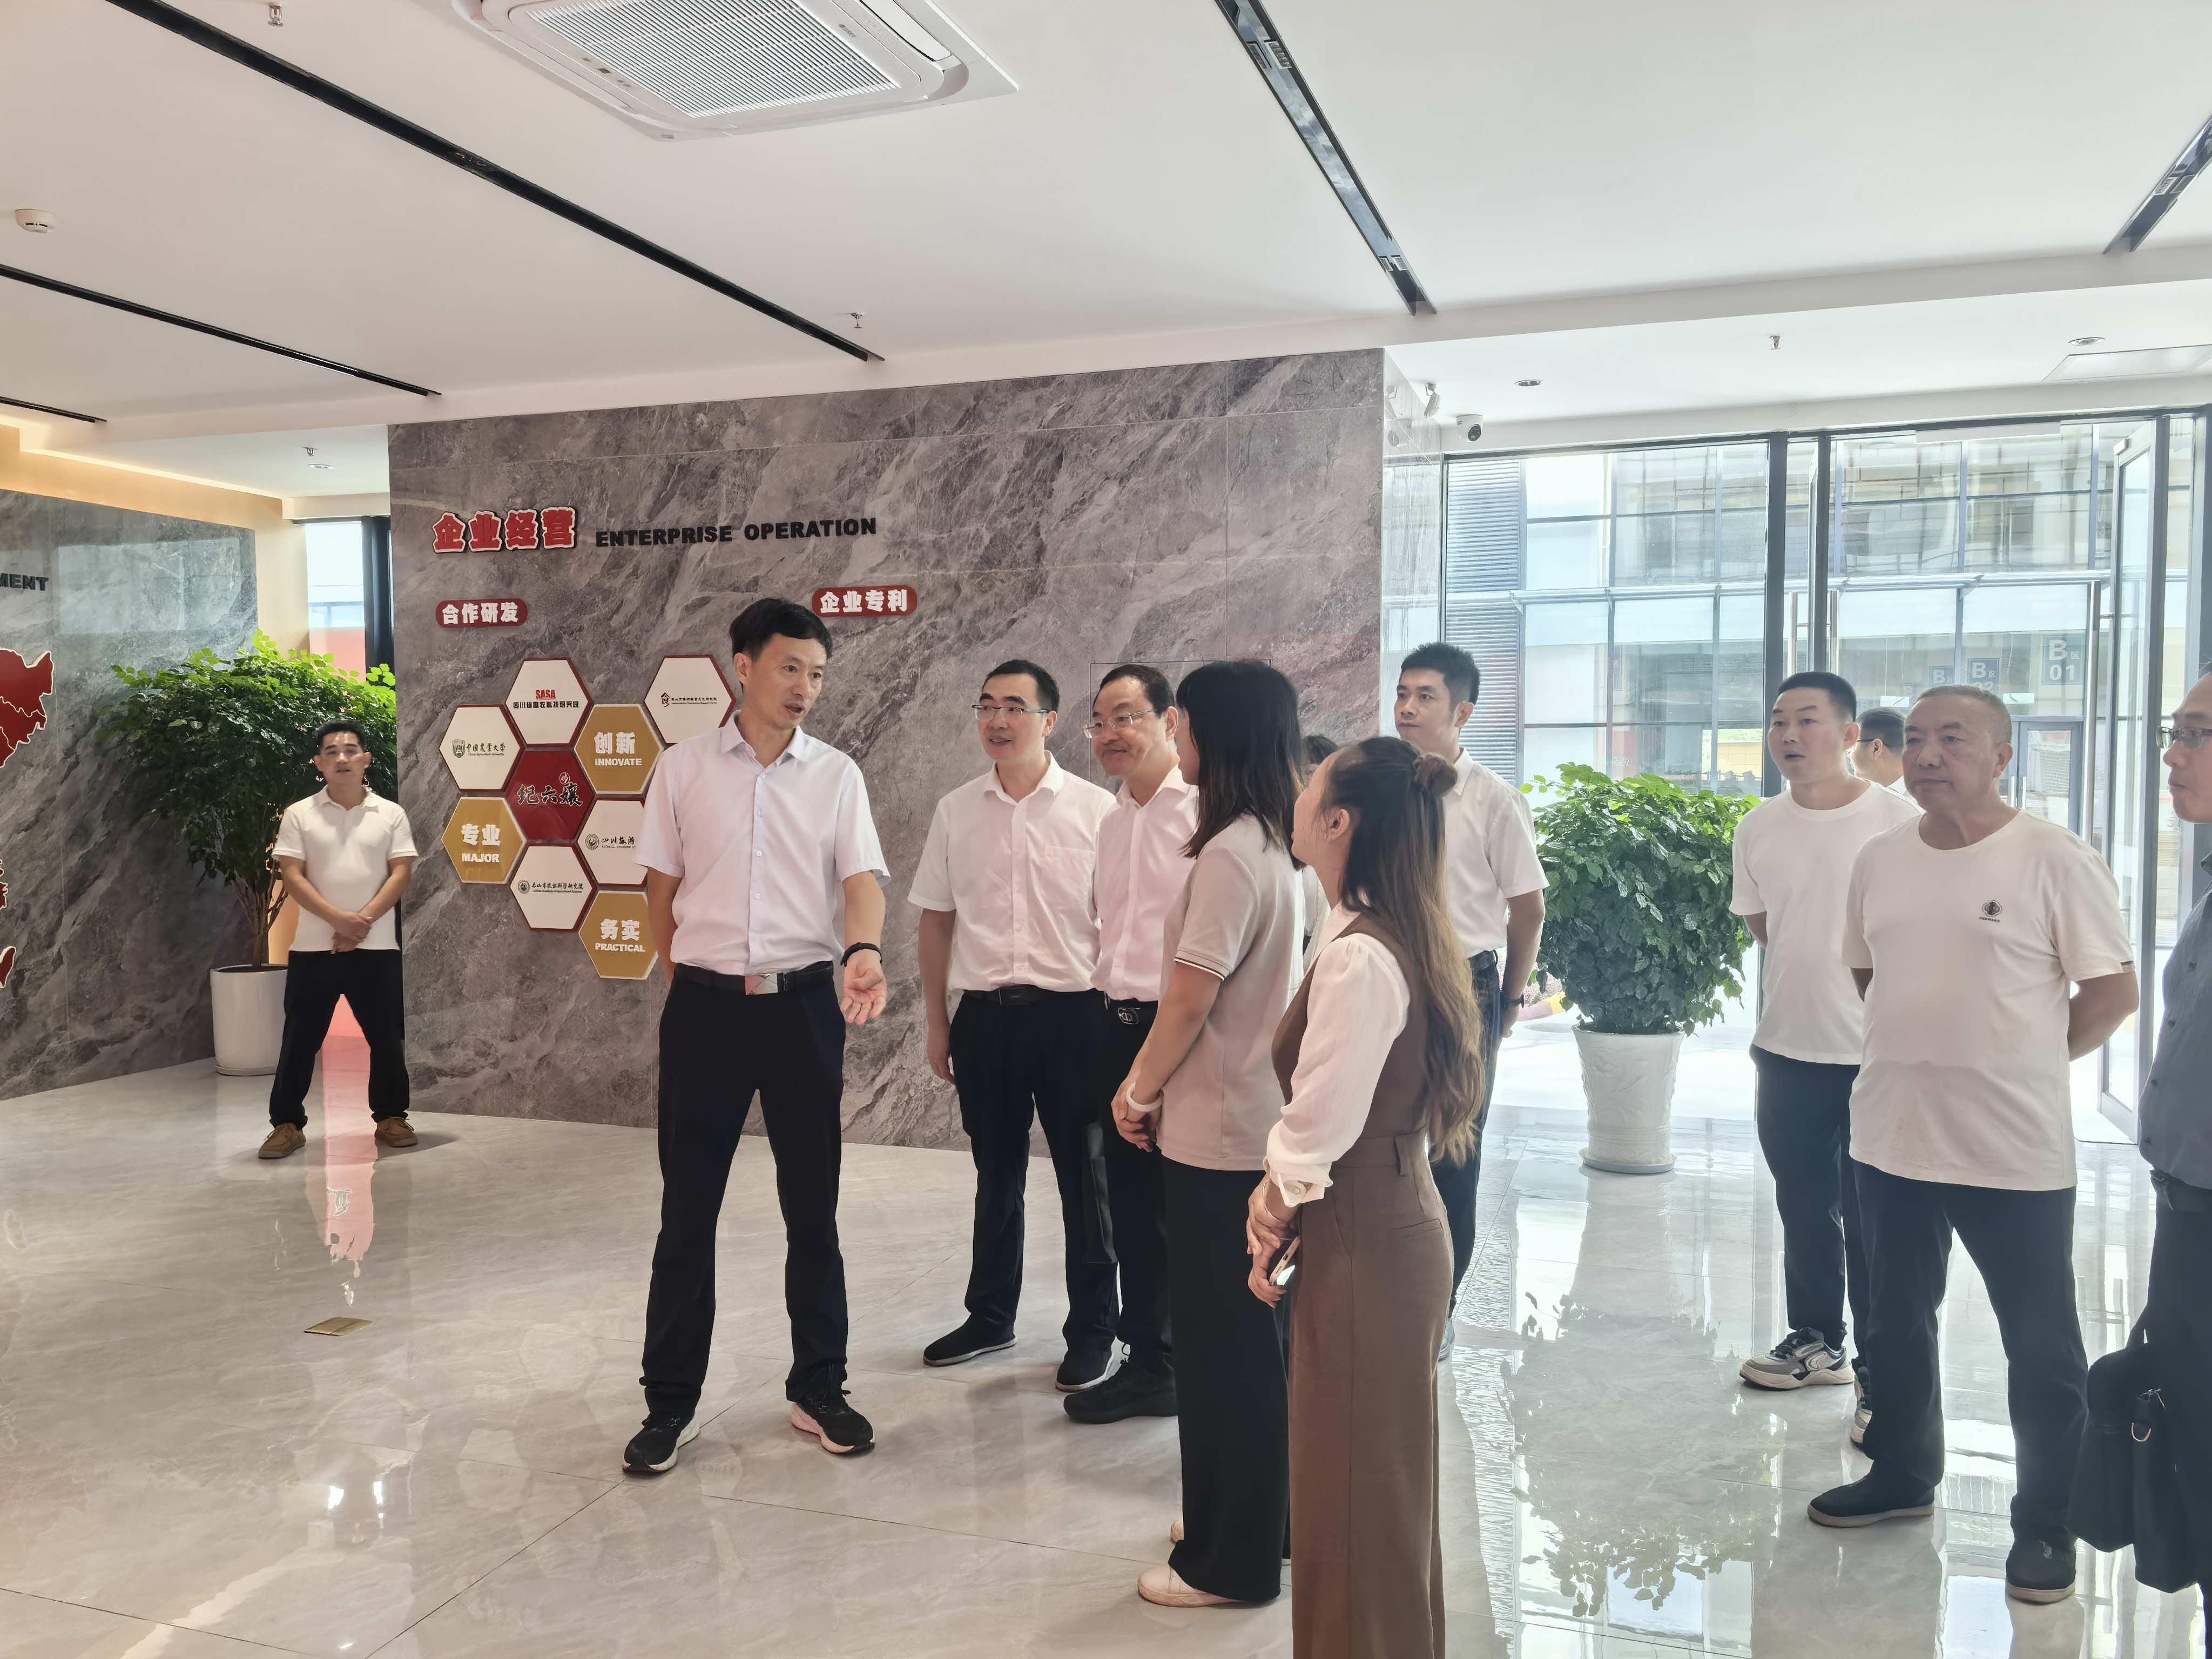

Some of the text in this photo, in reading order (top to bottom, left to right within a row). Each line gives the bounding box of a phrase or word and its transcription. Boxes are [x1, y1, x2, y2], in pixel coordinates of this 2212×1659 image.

[433, 507, 575, 552] 企业经营
[596, 518, 876, 547] ENTERPRISE OPERATION
[820, 589, 907, 613] 企业专利
[442, 602, 518, 624] 合作研发
[2049, 664, 2074, 680] 01
[536, 689, 556, 699] SASA
[594, 732, 635, 754] 创新
[595, 758, 642, 766] INNOVATE
[461, 824, 501, 846] 专业
[462, 853, 500, 863] MAJOR
[600, 919, 640, 941] 务实
[595, 943, 646, 952] PRACTICAL
